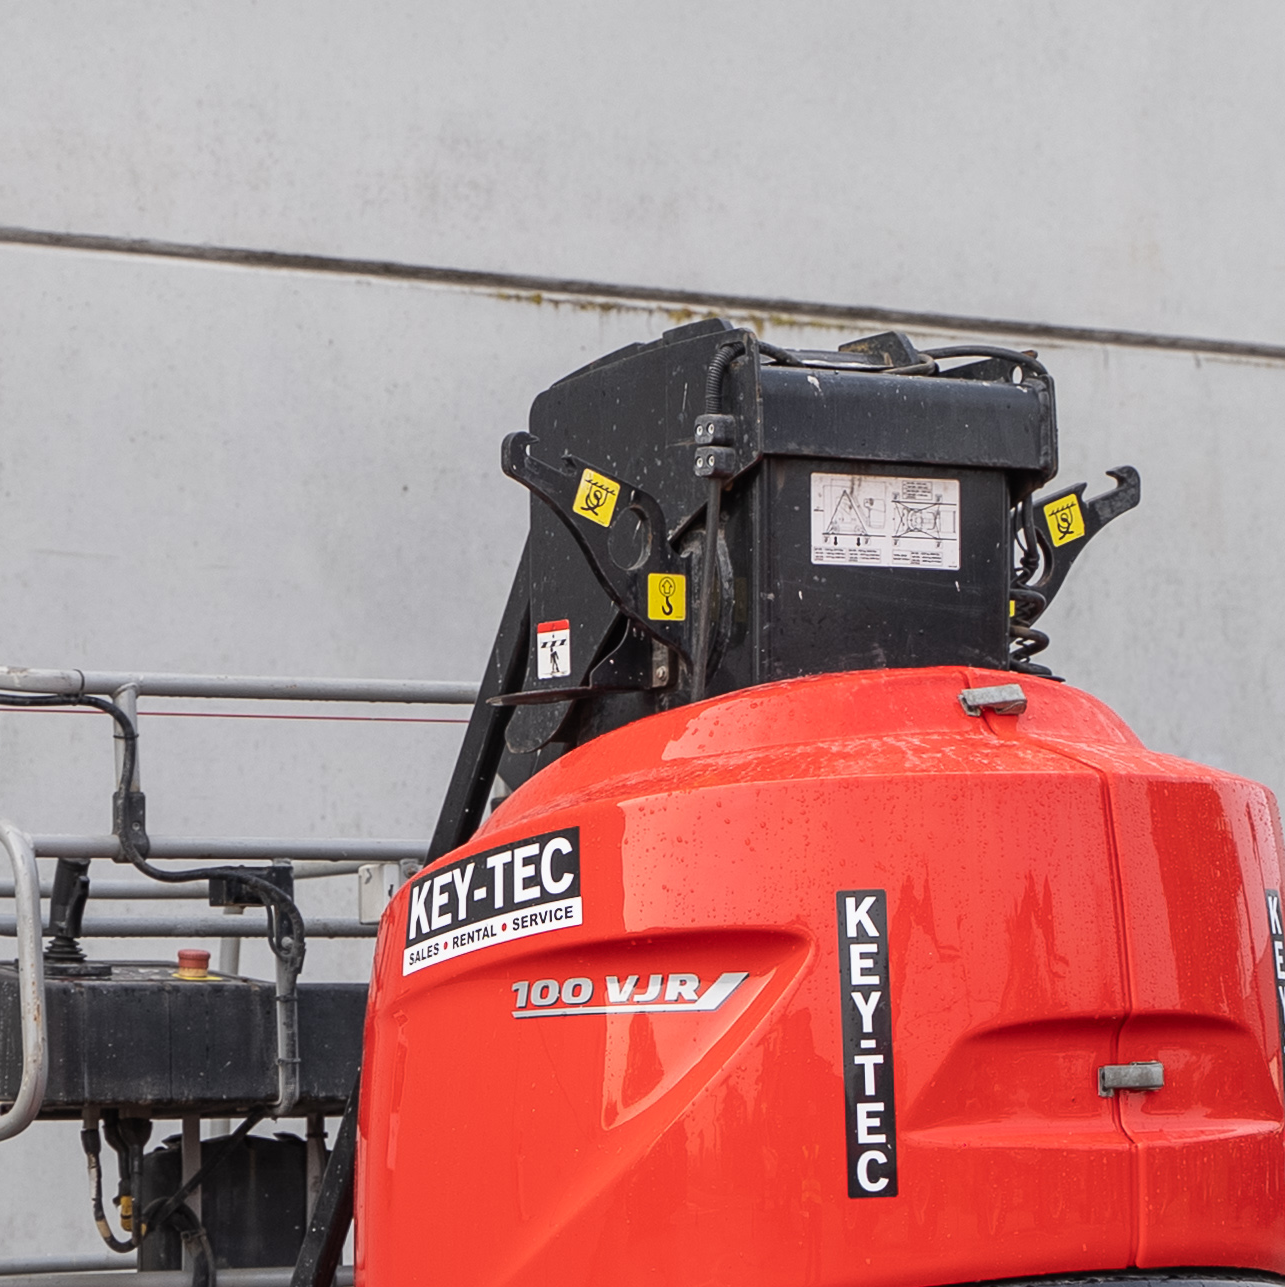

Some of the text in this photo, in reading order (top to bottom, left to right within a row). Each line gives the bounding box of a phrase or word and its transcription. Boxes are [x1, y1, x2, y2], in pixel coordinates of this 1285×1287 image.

[408, 836, 575, 940] KEY-TEC
[408, 905, 574, 966] SALES RENTAL SERVICE
[512, 973, 701, 1008] 100 VJR
[845, 895, 890, 1193] KEY-TEC
